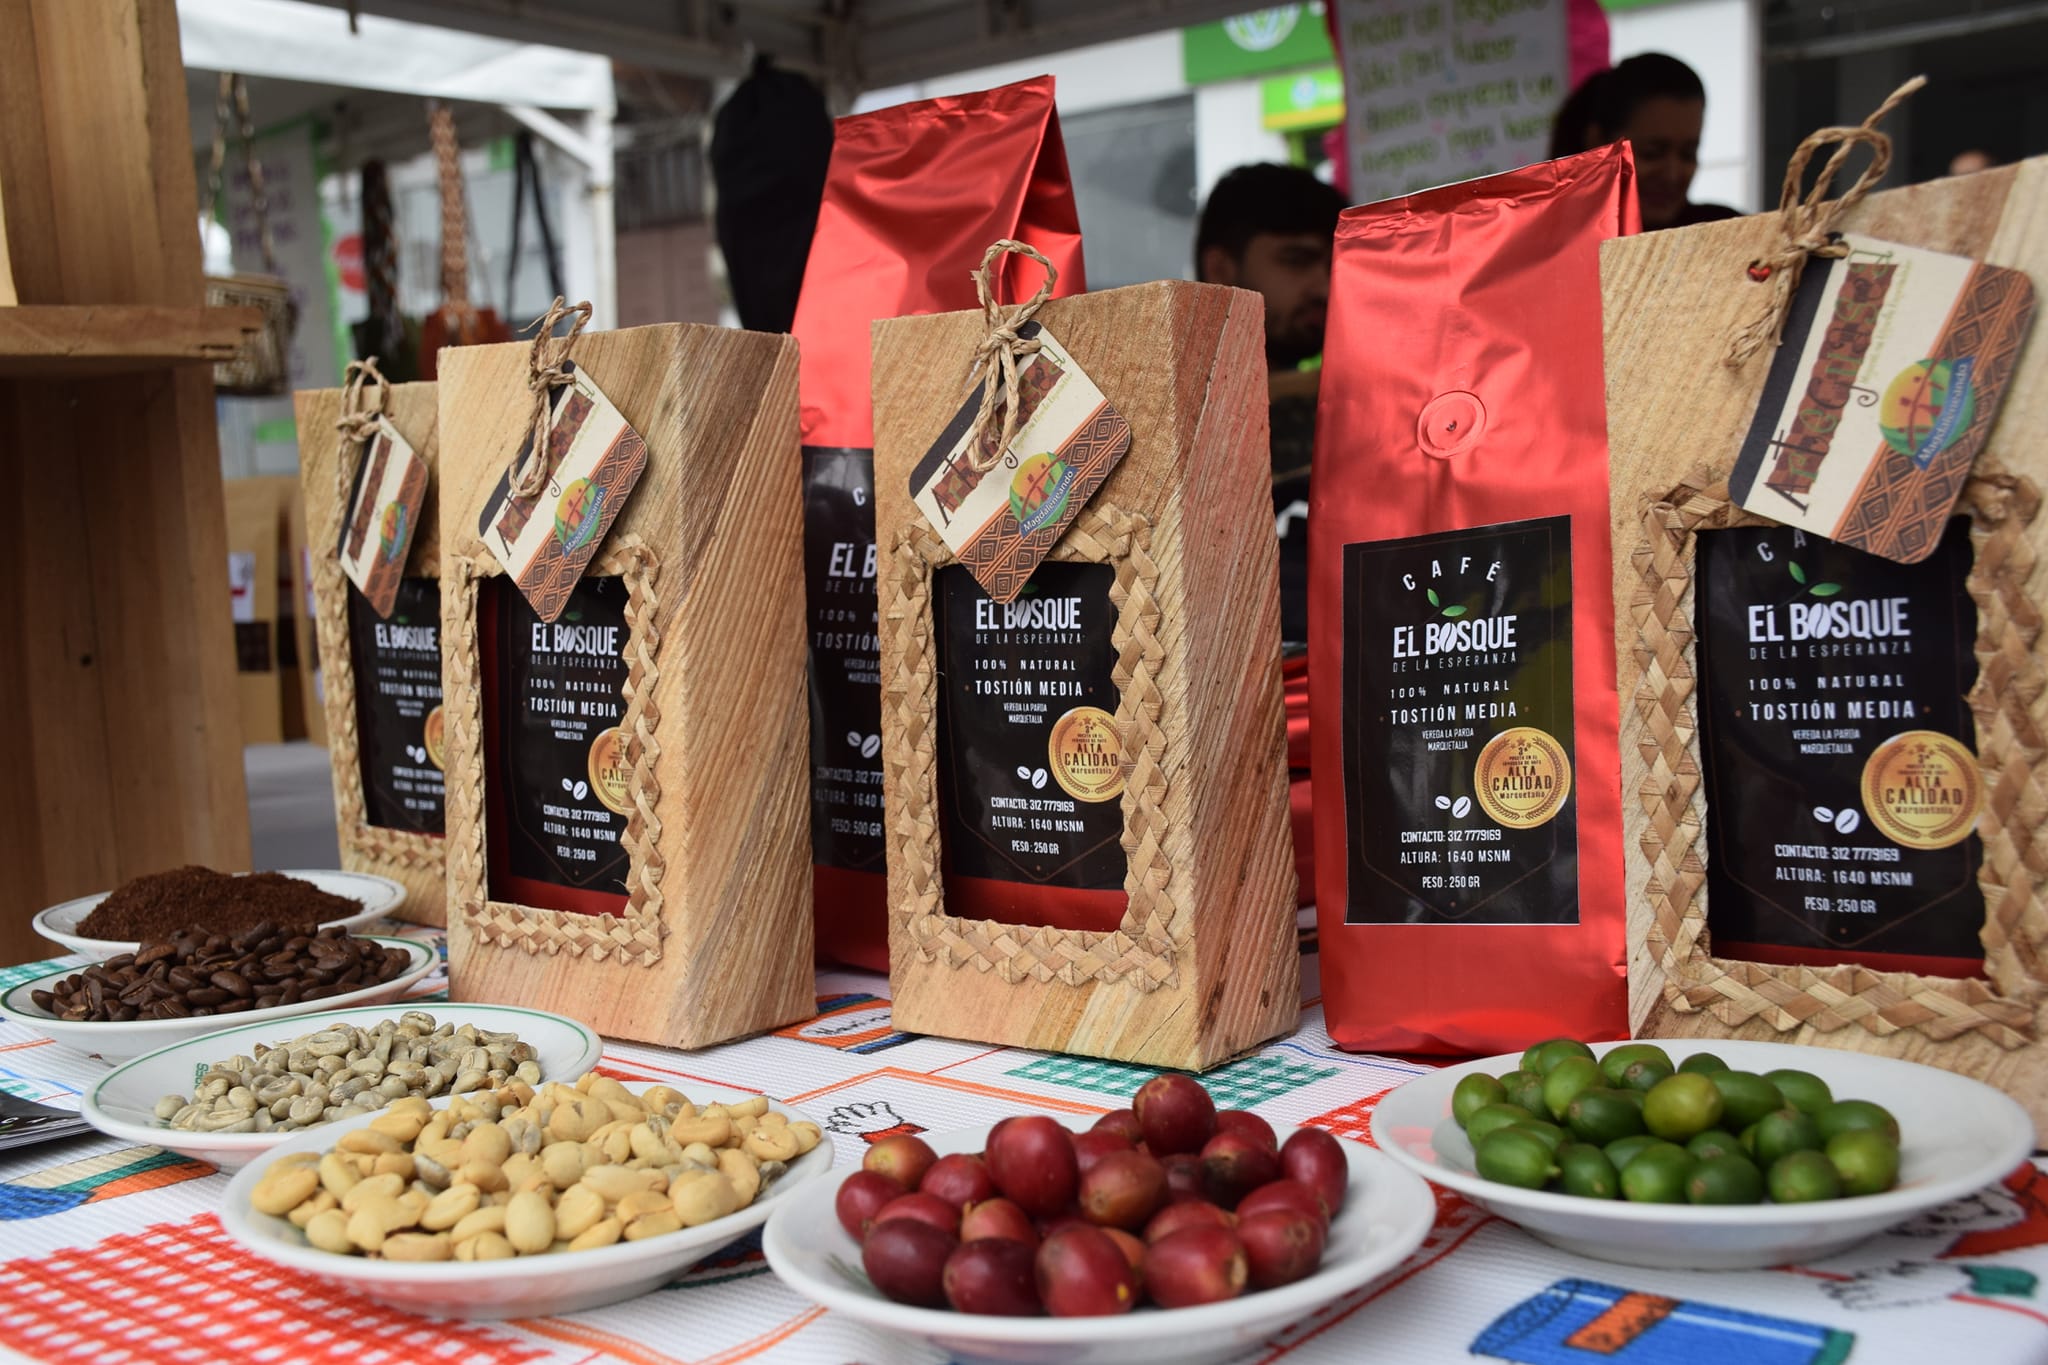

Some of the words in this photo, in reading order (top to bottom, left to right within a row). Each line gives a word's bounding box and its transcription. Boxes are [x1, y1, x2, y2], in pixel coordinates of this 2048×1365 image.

[1918, 364, 1966, 463] Magdaleneando
[1023, 470, 1074, 533] Magdaleneando
[828, 543, 857, 578] EL
[1402, 556, 1502, 591] CAFÉ
[976, 599, 999, 630] EL
[1004, 598, 1082, 630] BOSQUE
[1748, 605, 1782, 642] EL
[1790, 598, 1911, 640] BOSQUE
[376, 624, 390, 648] EL
[532, 624, 551, 652] EL
[554, 626, 618, 656] BOSQUE
[976, 634, 990, 644] DE
[996, 634, 1008, 644] LA
[1016, 632, 1081, 644] ESPERANZA
[1394, 626, 1419, 658] EL
[1426, 615, 1517, 654] BOSQUE
[1750, 646, 1767, 660] DE
[1780, 644, 1798, 658] LA
[1810, 641, 1911, 658] ESPERANZA
[532, 656, 545, 666] DE
[549, 656, 558, 667] LA
[562, 657, 618, 670] ESPERANZA
[975, 659, 1006, 670] 100%
[1020, 658, 1076, 670] NATURAL
[1393, 661, 1406, 672] DE
[1416, 658, 1430, 670] LA
[1440, 652, 1517, 668] ESPERANZA
[530, 678, 555, 690] 100%
[566, 680, 612, 694] NATURAL
[976, 678, 1032, 696] TOSTIÓN
[1039, 681, 1083, 696] MEDIA
[1391, 686, 1426, 698] 100%
[1444, 681, 1510, 695] NATURAL
[1750, 678, 1796, 690] 100%
[1818, 676, 1904, 688] NATURAL
[530, 694, 575, 716] TOSTIÓN
[581, 703, 618, 718] MEDIA
[1391, 704, 1456, 724] TOSTIÓN
[1466, 702, 1517, 720] MEDIA
[1751, 700, 1835, 720] TOSTIÓN
[1848, 702, 1914, 718] MEDIA
[1009, 714, 1042, 724] MARQUETALIA
[1077, 744, 1102, 753] ALTA
[1428, 740, 1468, 750] MARQUETALIA
[1800, 744, 1853, 754] MARQUETALIA
[1064, 752, 1118, 766] CALIDAD
[1508, 766, 1536, 776] ALTA
[1493, 776, 1552, 791] CALIDAD
[1906, 776, 1941, 788] ALTA
[1886, 788, 1962, 804] CALIDAD
[991, 797, 1028, 810] CONTACTO:
[1030, 798, 1042, 810] 312
[1043, 799, 1074, 812] 7779169
[570, 808, 581, 820] 312
[544, 822, 568, 836] ALTURA:
[571, 826, 590, 839] 1640
[594, 828, 616, 842] MSNM
[992, 816, 1026, 830] ALTURA:
[1030, 818, 1052, 831] 1640
[1056, 820, 1084, 833] MSNM
[1402, 831, 1445, 842] CONTACTO:
[1448, 830, 1462, 842] 312
[1464, 829, 1501, 841] 7779169
[574, 847, 586, 860] 250
[586, 848, 596, 861] GR
[1034, 841, 1048, 854] 250
[1049, 842, 1060, 854] GR
[1775, 844, 1830, 860] CONTACTO:
[1832, 846, 1850, 860] 312
[1852, 846, 1899, 862] 7779169
[1400, 852, 1441, 864] ALTURA:
[1447, 850, 1474, 864] 1640
[1478, 850, 1510, 862] MSNM
[1450, 876, 1466, 888] 250
[1468, 876, 1480, 887] GR
[1776, 867, 1826, 883] ALTURA:
[1832, 870, 1866, 885] 1640
[1870, 870, 1913, 886] MSNM
[1837, 898, 1858, 912] 250
[1860, 899, 1876, 914] GR
